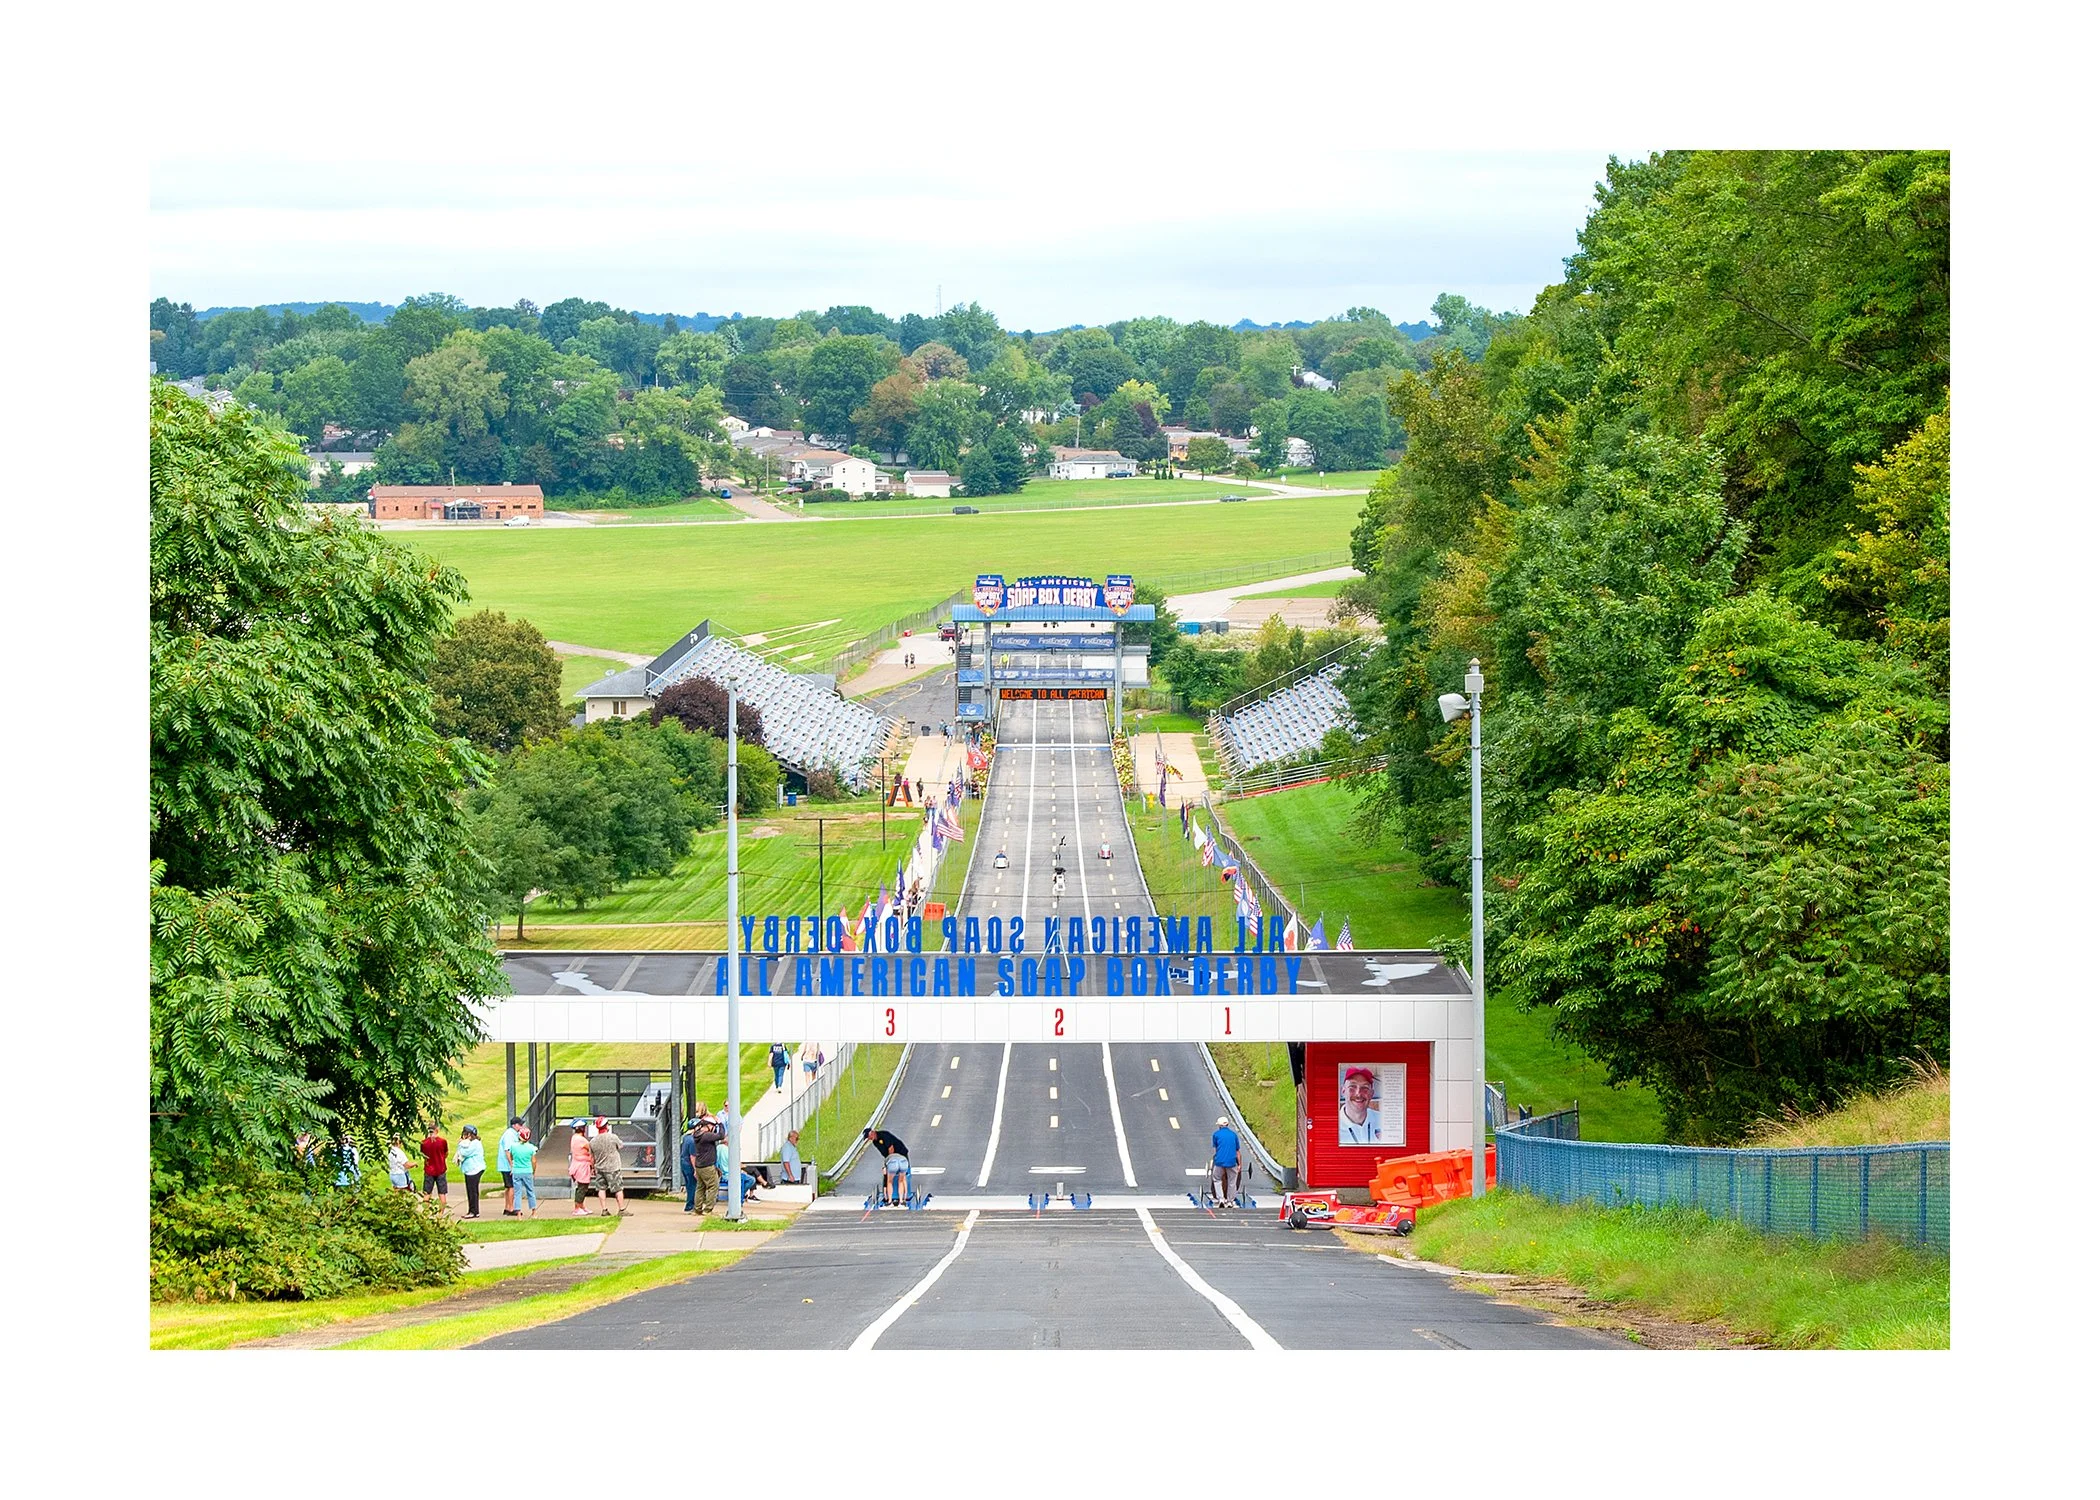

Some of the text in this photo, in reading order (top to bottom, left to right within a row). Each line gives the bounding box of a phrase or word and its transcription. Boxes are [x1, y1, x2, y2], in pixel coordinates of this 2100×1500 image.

[1015, 578, 1092, 588] ALL-AMERICAN
[1006, 587, 1098, 610] SOAP BOX DERBY
[1001, 689, 1105, 699] WELCOME TO ALL AMERICAN
[715, 957, 1302, 996] ALL AMERICAN SOAP BOX DERBY
[885, 1008, 895, 1036] 3
[1054, 1008, 1064, 1036] 2
[1224, 1007, 1232, 1035] 1
